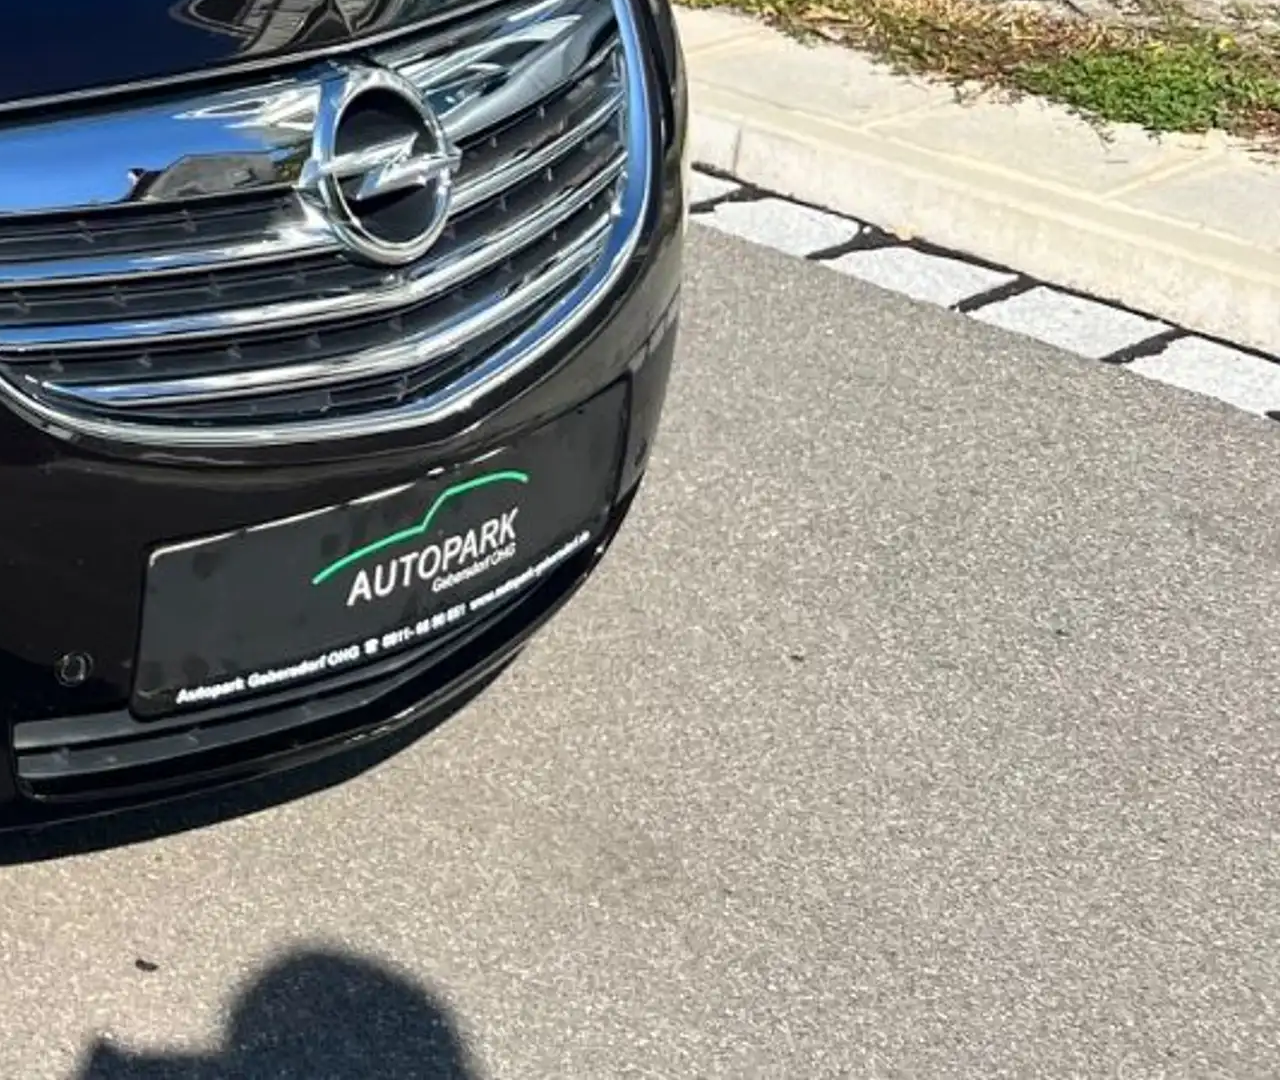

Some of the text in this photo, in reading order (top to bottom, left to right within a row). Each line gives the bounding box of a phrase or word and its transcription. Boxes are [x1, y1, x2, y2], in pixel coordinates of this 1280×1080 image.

[346, 506, 519, 607] AUTOPARK
[431, 541, 517, 593] Gebersdorf OHG
[175, 676, 245, 704] Autopark
[247, 654, 327, 688] Gebersdorf
[326, 644, 360, 666] OHG
